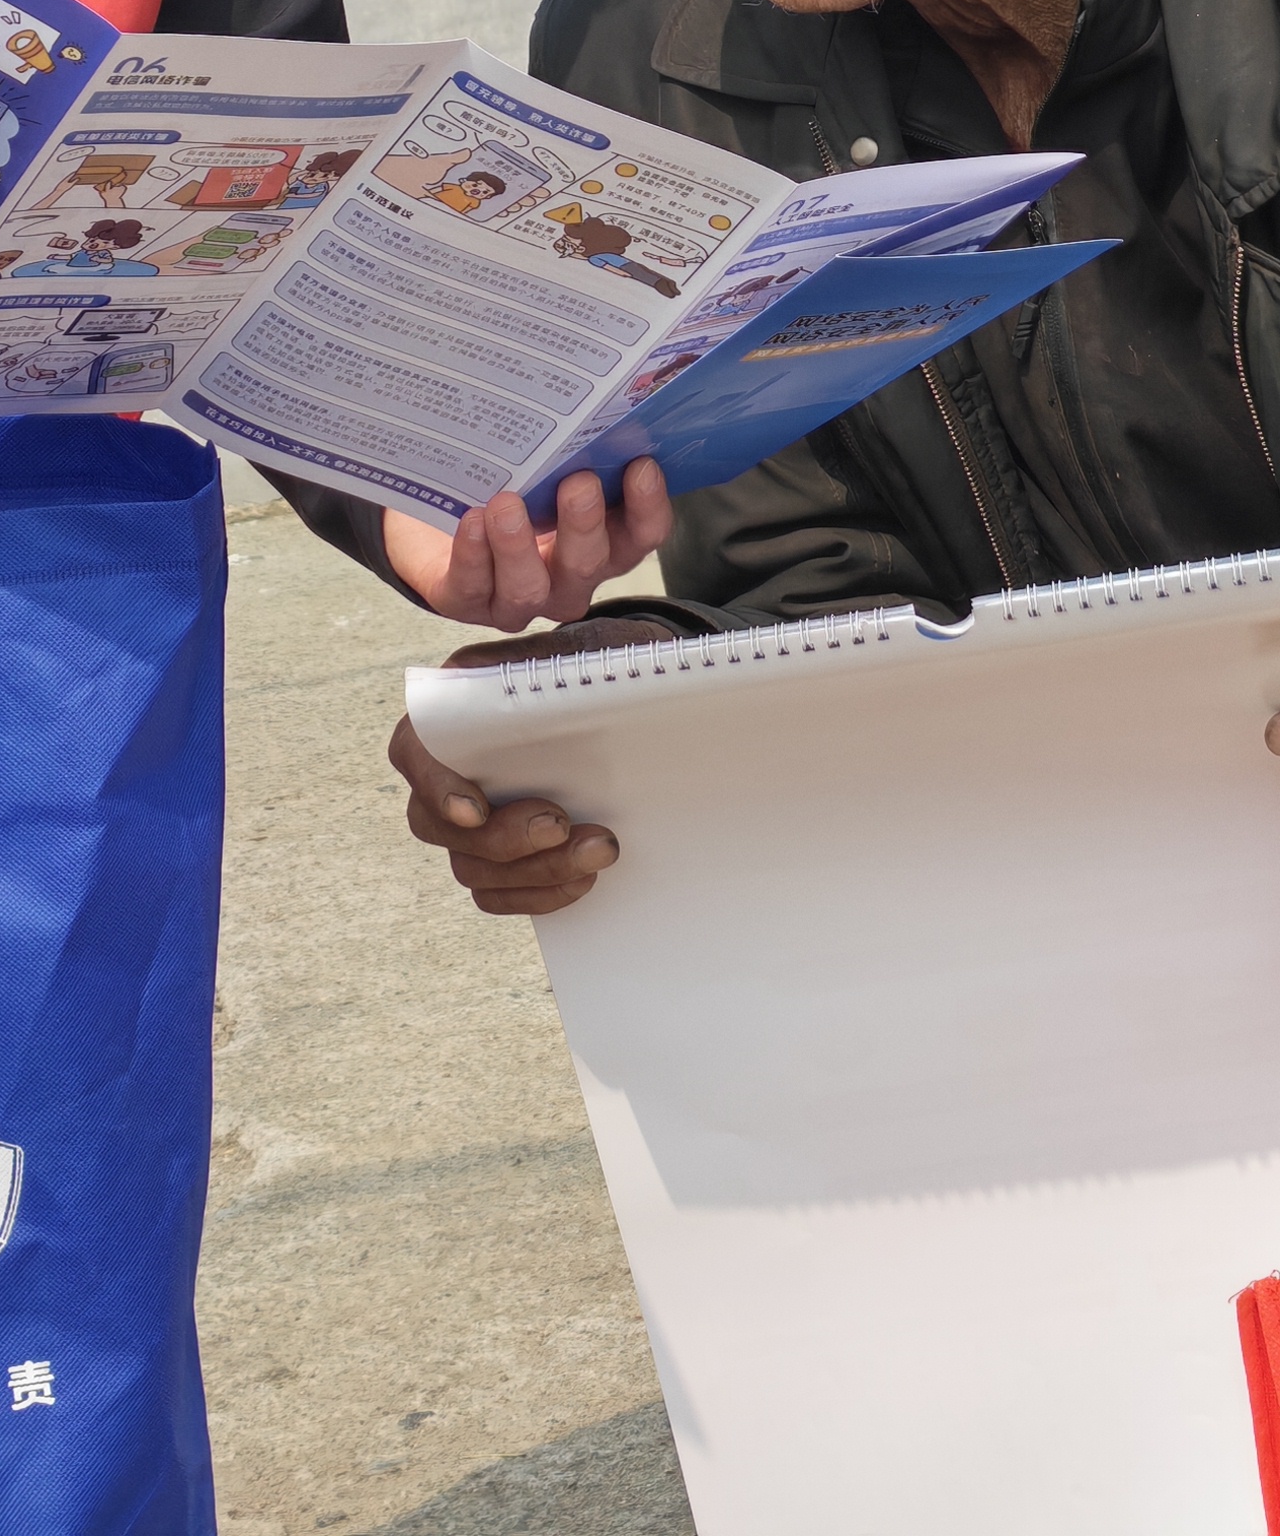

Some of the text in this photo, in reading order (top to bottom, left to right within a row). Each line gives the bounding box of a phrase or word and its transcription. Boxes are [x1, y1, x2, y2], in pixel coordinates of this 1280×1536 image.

[105, 74, 212, 87] 电信网络诈骗
[465, 79, 596, 144] 冒充领导、熟人类诈骗
[362, 188, 416, 220] 防范建议
